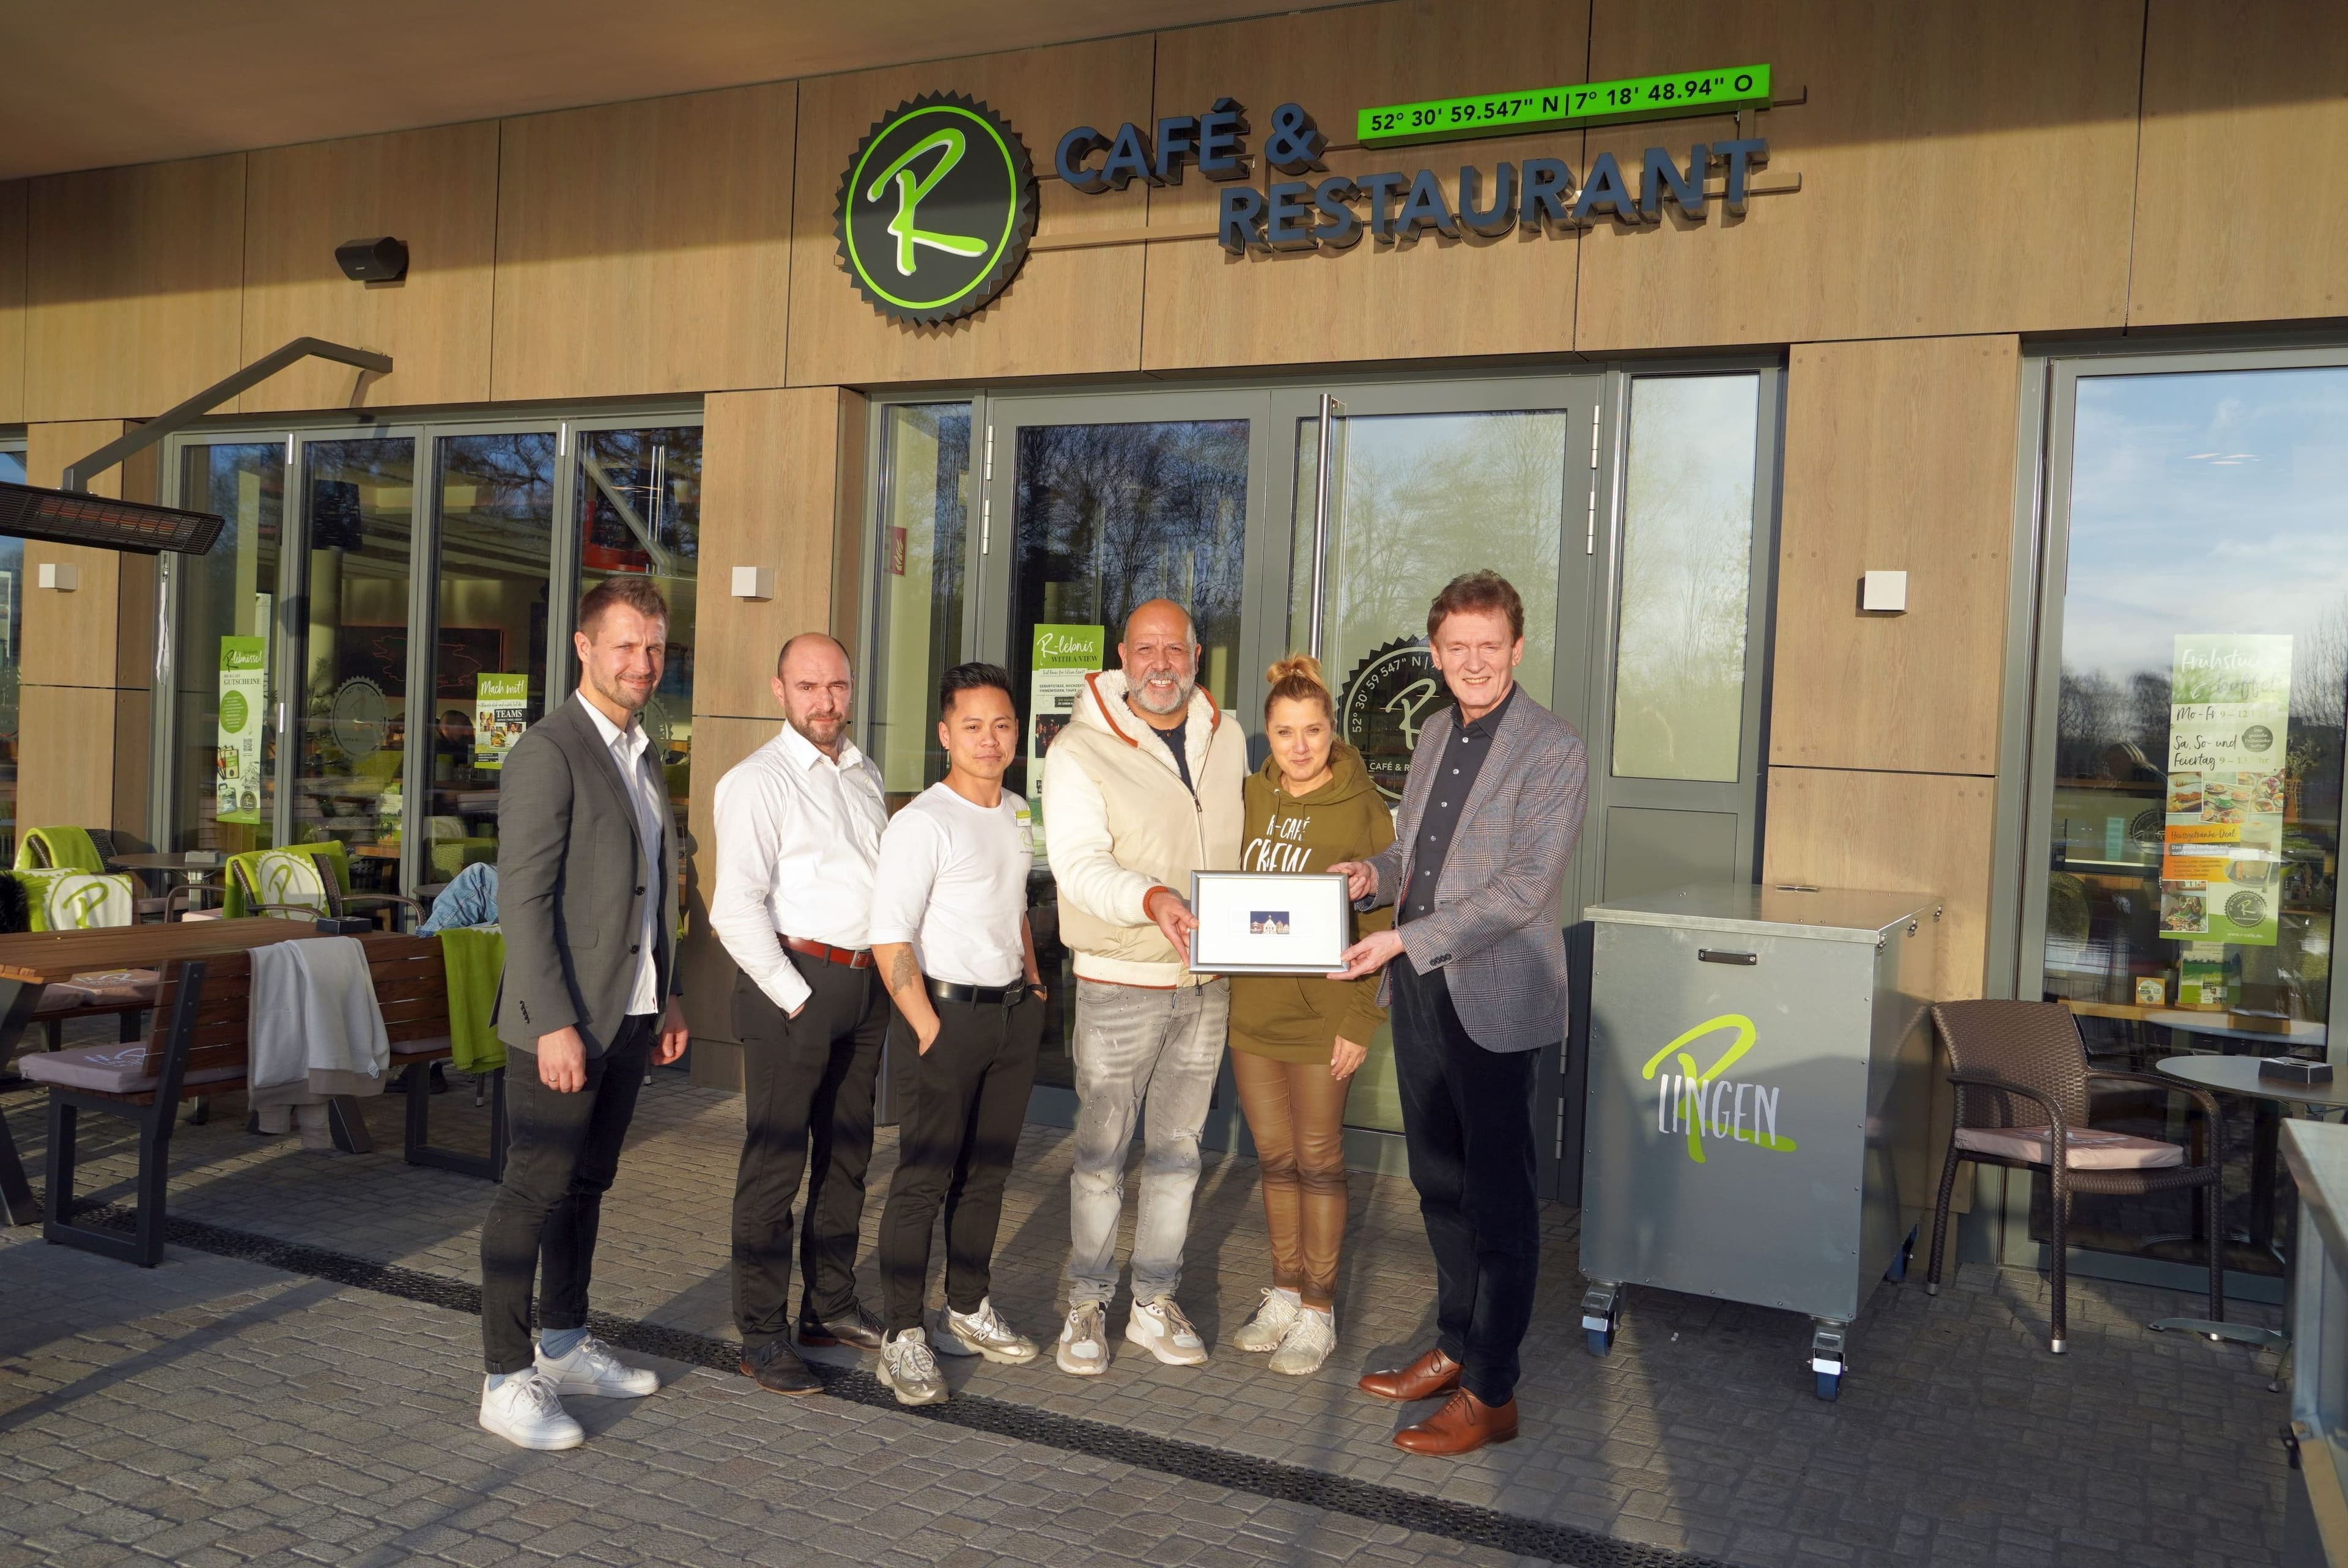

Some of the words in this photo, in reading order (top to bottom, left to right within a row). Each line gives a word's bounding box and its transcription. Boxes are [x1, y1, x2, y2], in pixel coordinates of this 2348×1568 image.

[1371, 112, 1405, 131] 52°
[1411, 107, 1442, 127] 30'
[1450, 98, 1534, 122] 59.547"
[1607, 87, 1639, 106] 18'
[1648, 78, 1725, 101] 48.94"
[1055, 98, 1244, 186] CAFÉ
[1265, 103, 1328, 174] &
[1219, 138, 1767, 251] RESTAURANT
[481, 680, 504, 696] Mach
[506, 680, 524, 696] mit!
[2177, 707, 2196, 721] Mo
[2216, 735, 2237, 749] und
[1370, 762, 1392, 771] CAFÉ
[2174, 753, 2215, 771] Feiertag
[1242, 838, 1312, 872] CREW
[1659, 1074, 1780, 1146] LINGEN
